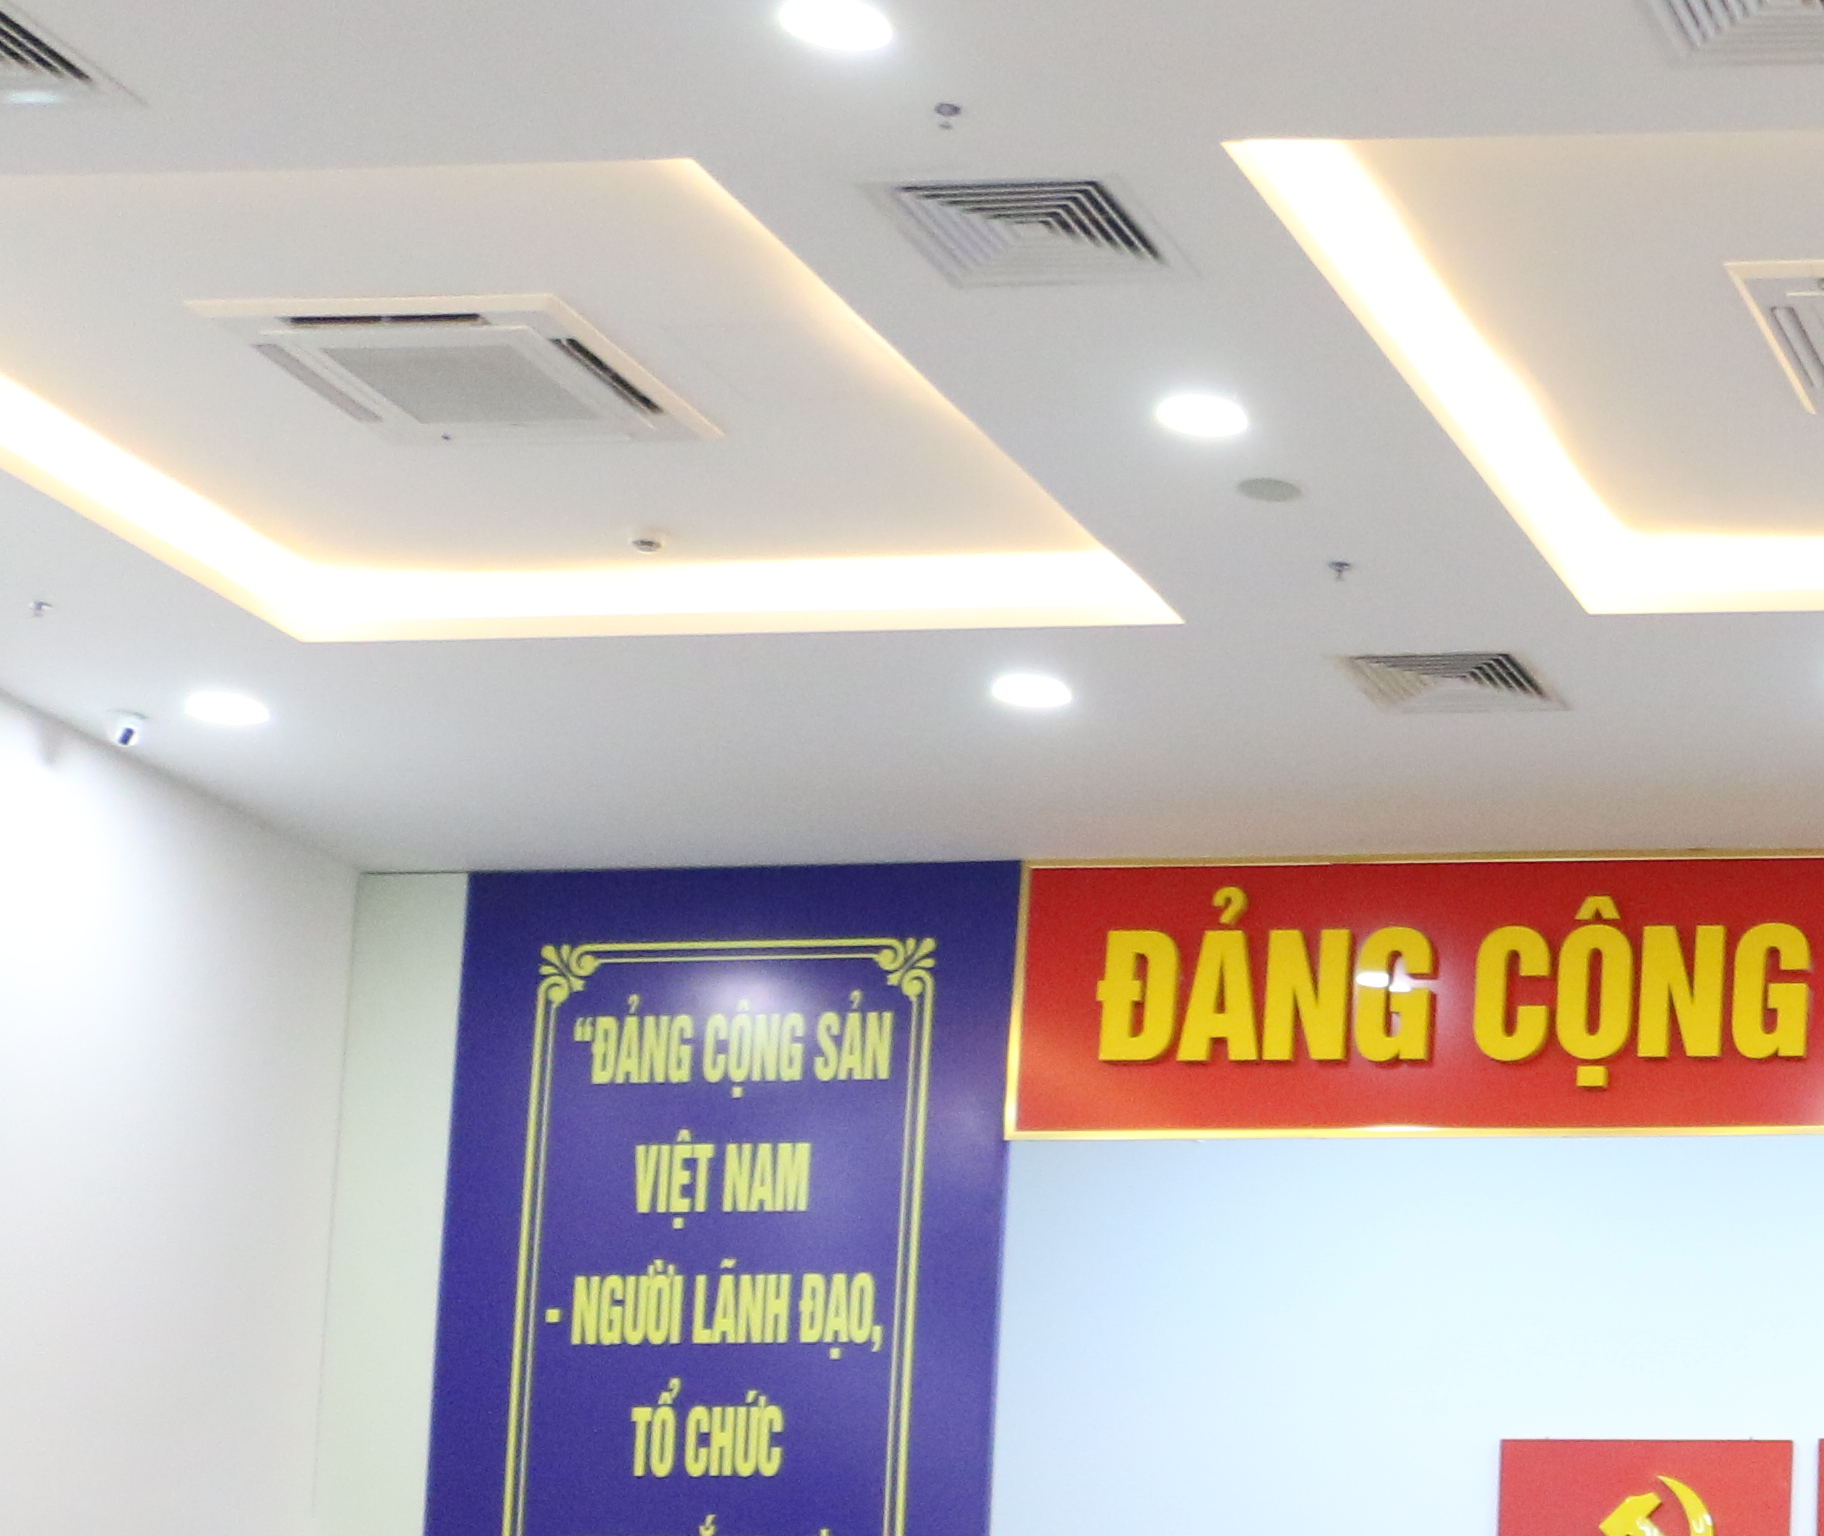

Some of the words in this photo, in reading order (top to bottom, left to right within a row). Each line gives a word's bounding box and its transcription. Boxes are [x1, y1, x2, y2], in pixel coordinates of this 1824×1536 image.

[1096, 887, 1430, 1062] ĐẢNG
[1472, 896, 1809, 1088] CỘNG
[573, 995, 692, 1084] “ĐẢNG
[704, 999, 803, 1097] CỘNG
[815, 991, 893, 1080] SẢN
[636, 1130, 714, 1228] VIỆT
[723, 1143, 810, 1211] NAM
[571, 1260, 683, 1344] NGƯỜI
[692, 1259, 791, 1343] LÃNH
[799, 1273, 882, 1358] ĐẠO,
[632, 1378, 679, 1477] TỔ
[685, 1391, 783, 1476] CHỨC
